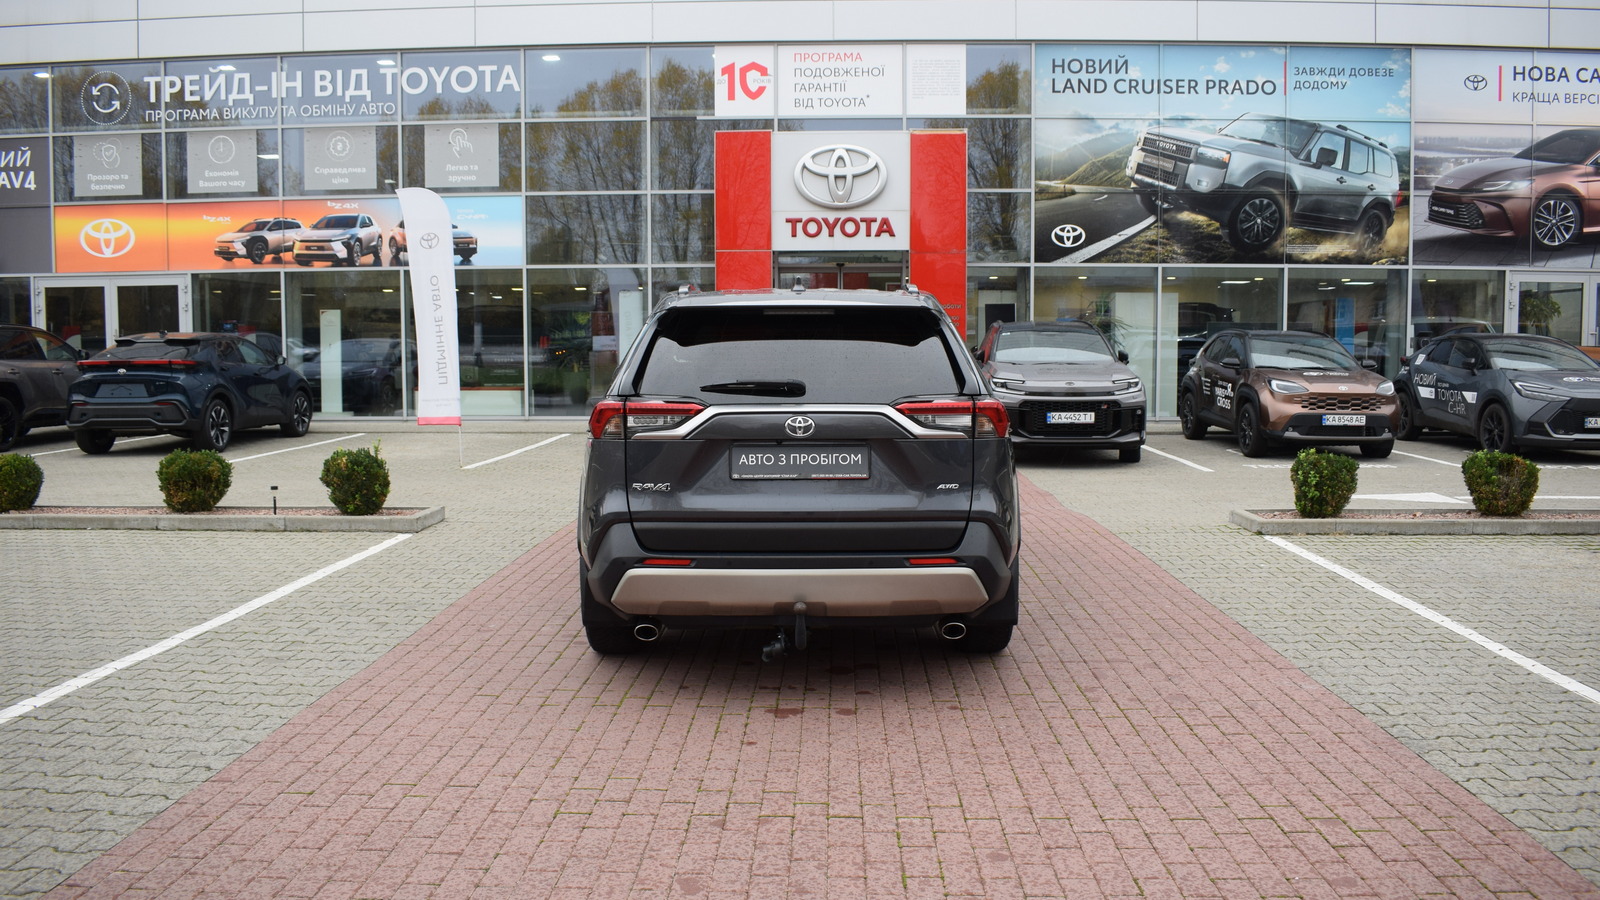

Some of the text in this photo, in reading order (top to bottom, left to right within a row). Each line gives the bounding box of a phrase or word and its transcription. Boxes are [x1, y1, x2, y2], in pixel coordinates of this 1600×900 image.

[793, 52, 863, 63] ПРОГРАМА
[1051, 54, 1129, 75] НОВИЙ
[793, 65, 885, 79] ПОДОВЖЕНОЇ
[1293, 66, 1395, 79] ЗАВЖДИ ДОВЕЗЕ
[1512, 65, 1570, 83] НОВА
[144, 65, 521, 106] ТРЕЙД-ІН ВІД TOYOTA
[793, 80, 846, 93] ГАРАНТІЇ
[1051, 78, 1277, 96] LAND CRUISER PRADO
[1293, 80, 1348, 91] ДОДОМУ
[794, 98, 814, 109] ВІД
[1512, 92, 1560, 105] КРАЩА
[145, 102, 396, 122] ПРОГРАМА ВИКУПУ ТА ОБМІНУ АВТО
[1156, 140, 1176, 151] TOYOTA
[204, 169, 239, 178] Економія
[314, 166, 367, 176] Справедлива
[445, 164, 467, 173] Легко
[87, 174, 119, 182] Прозоро
[199, 180, 246, 189] Вашого часу
[332, 176, 349, 185] ціна
[448, 174, 477, 183] зручно
[785, 217, 896, 238] TOYOTA
[1413, 373, 1437, 386] НОВИЙ
[1437, 388, 1463, 402] TOYOTA
[1216, 396, 1231, 410] CROSS
[1448, 402, 1466, 415] C-HR
[1051, 413, 1062, 421] KA
[1064, 413, 1082, 421] 4452
[1337, 416, 1354, 424] 8548
[1355, 416, 1365, 424] AE
[738, 453, 862, 466] АВТО З ПРОБІГОМ
[631, 482, 671, 492] RAV4
